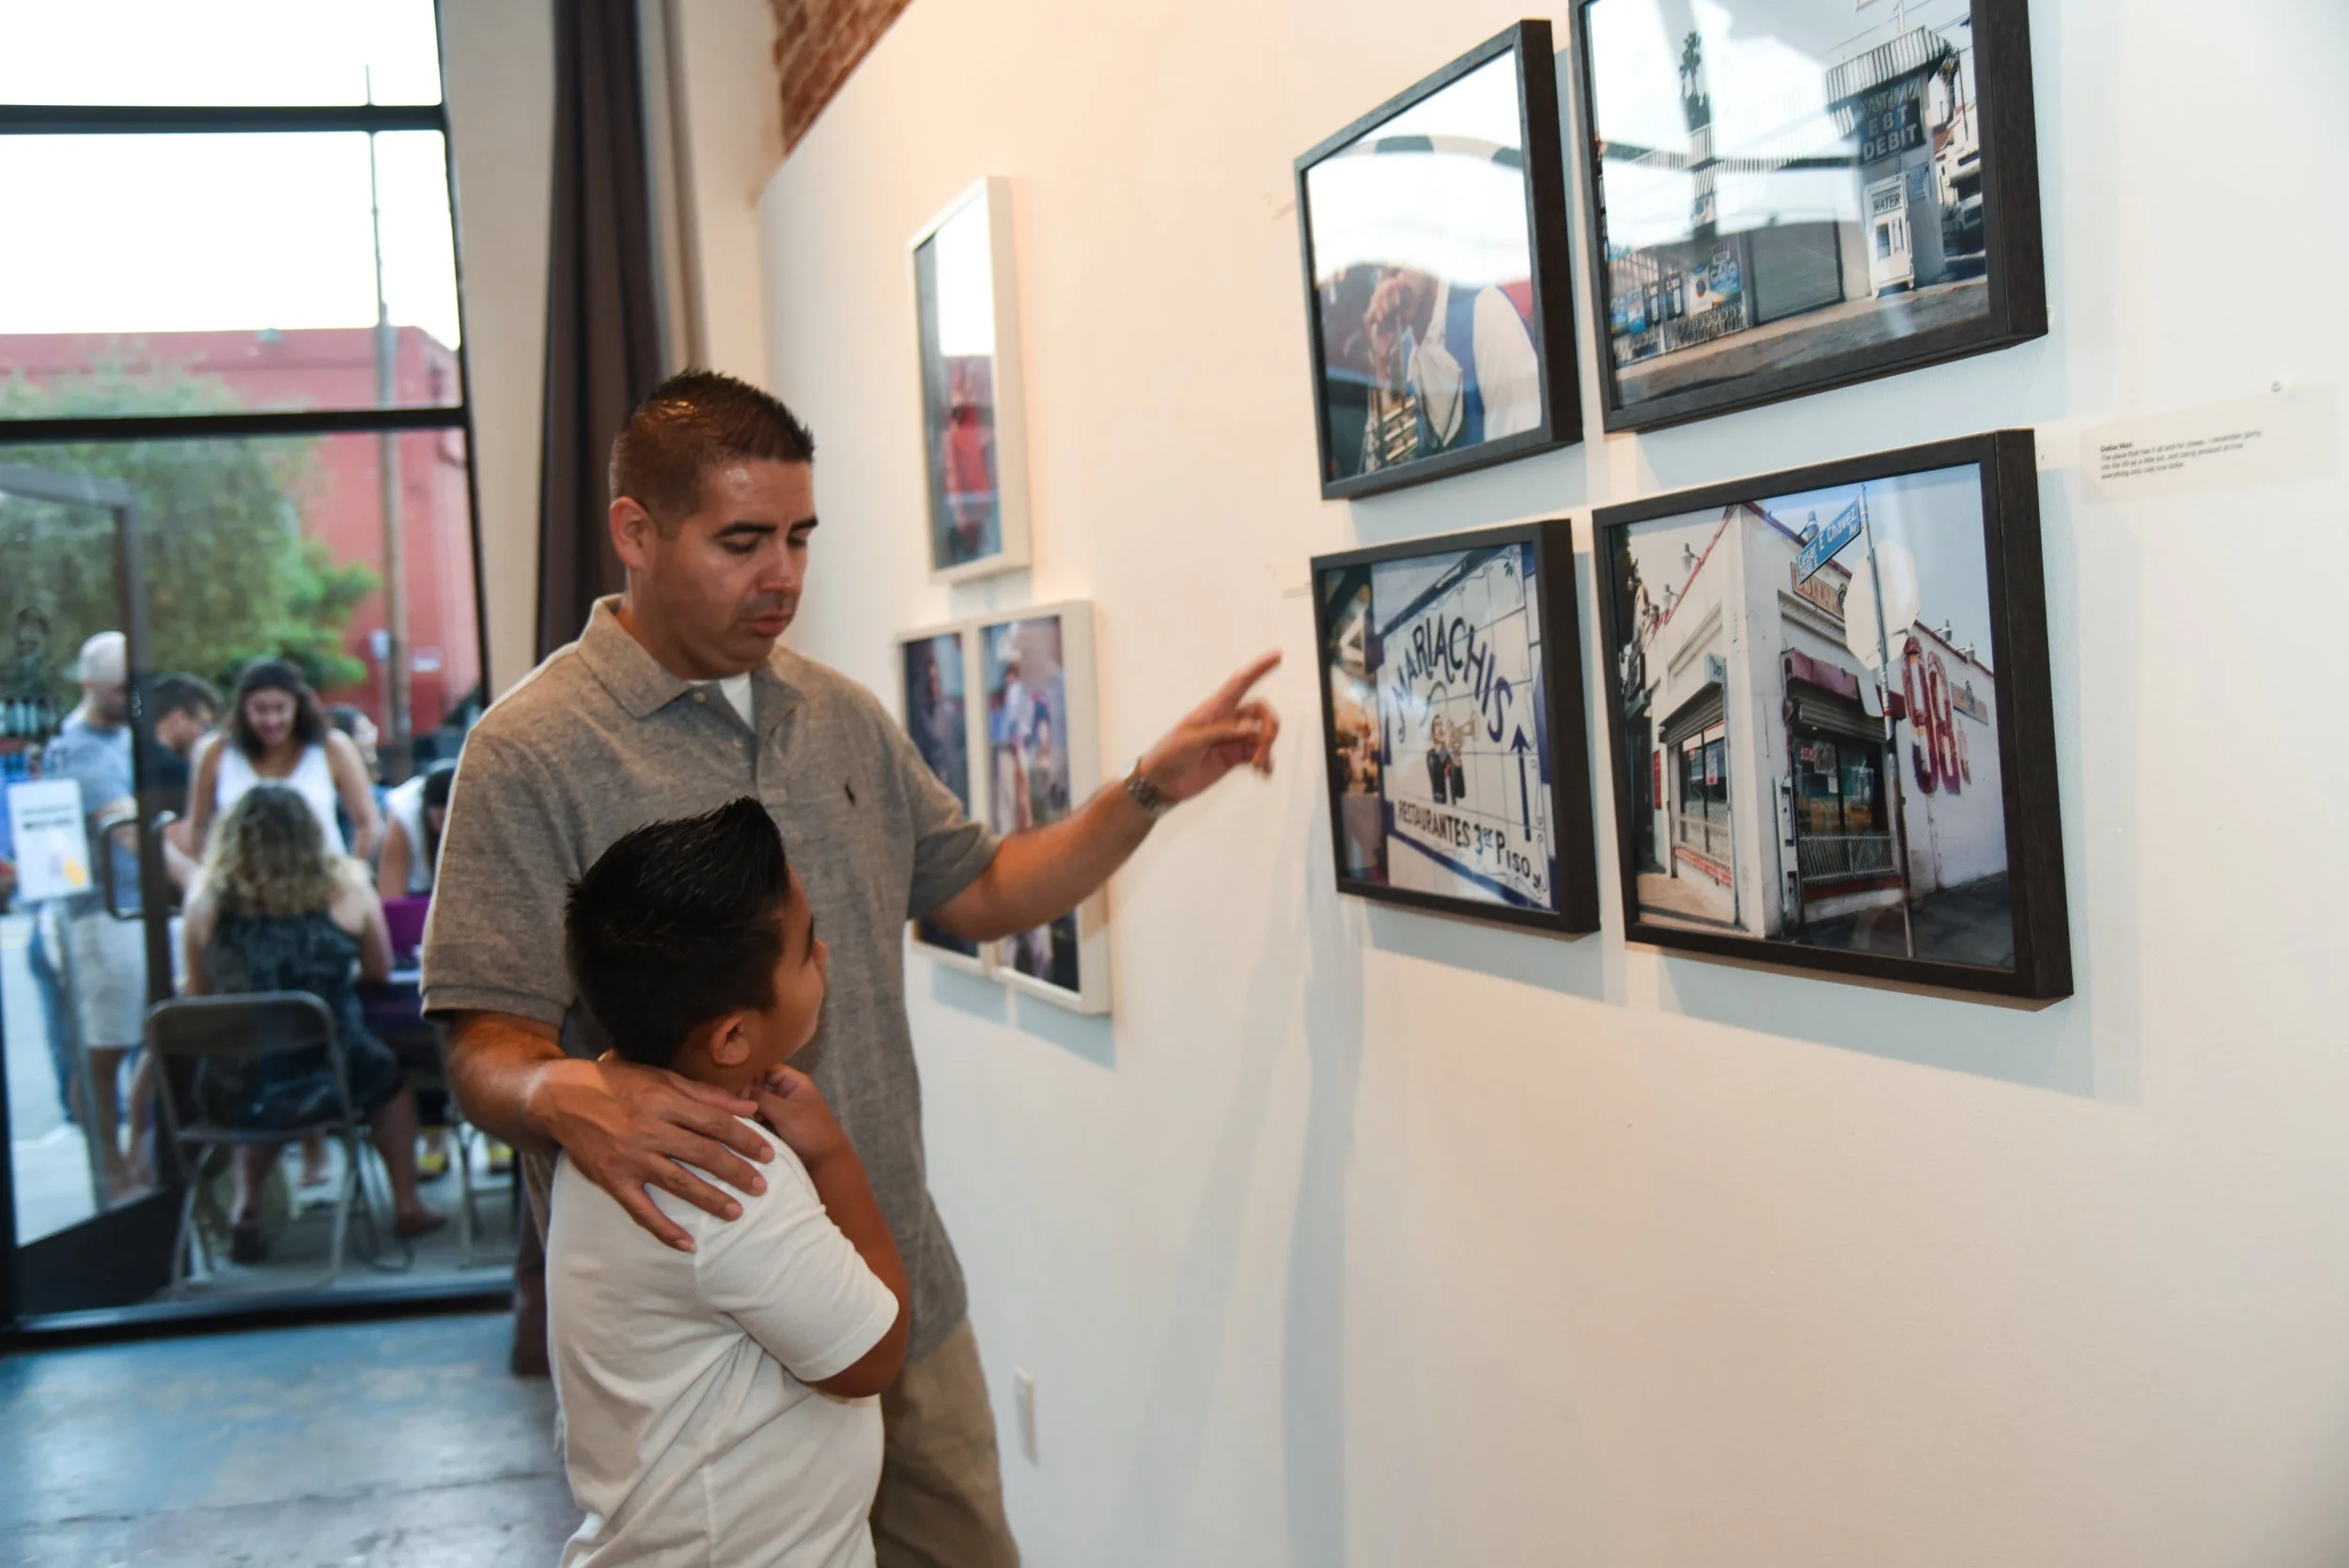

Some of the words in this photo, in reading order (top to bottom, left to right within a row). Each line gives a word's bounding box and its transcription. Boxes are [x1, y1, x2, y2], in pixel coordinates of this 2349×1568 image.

[1868, 104, 1908, 138] EBT
[1862, 123, 1917, 163] DEBIT
[1873, 192, 1901, 211] WATER
[1819, 533, 1825, 551] E
[1827, 507, 1856, 543] Chavez
[1392, 613, 1513, 743] MARIACHIS
[1398, 800, 1470, 847] RESTAURANTES
